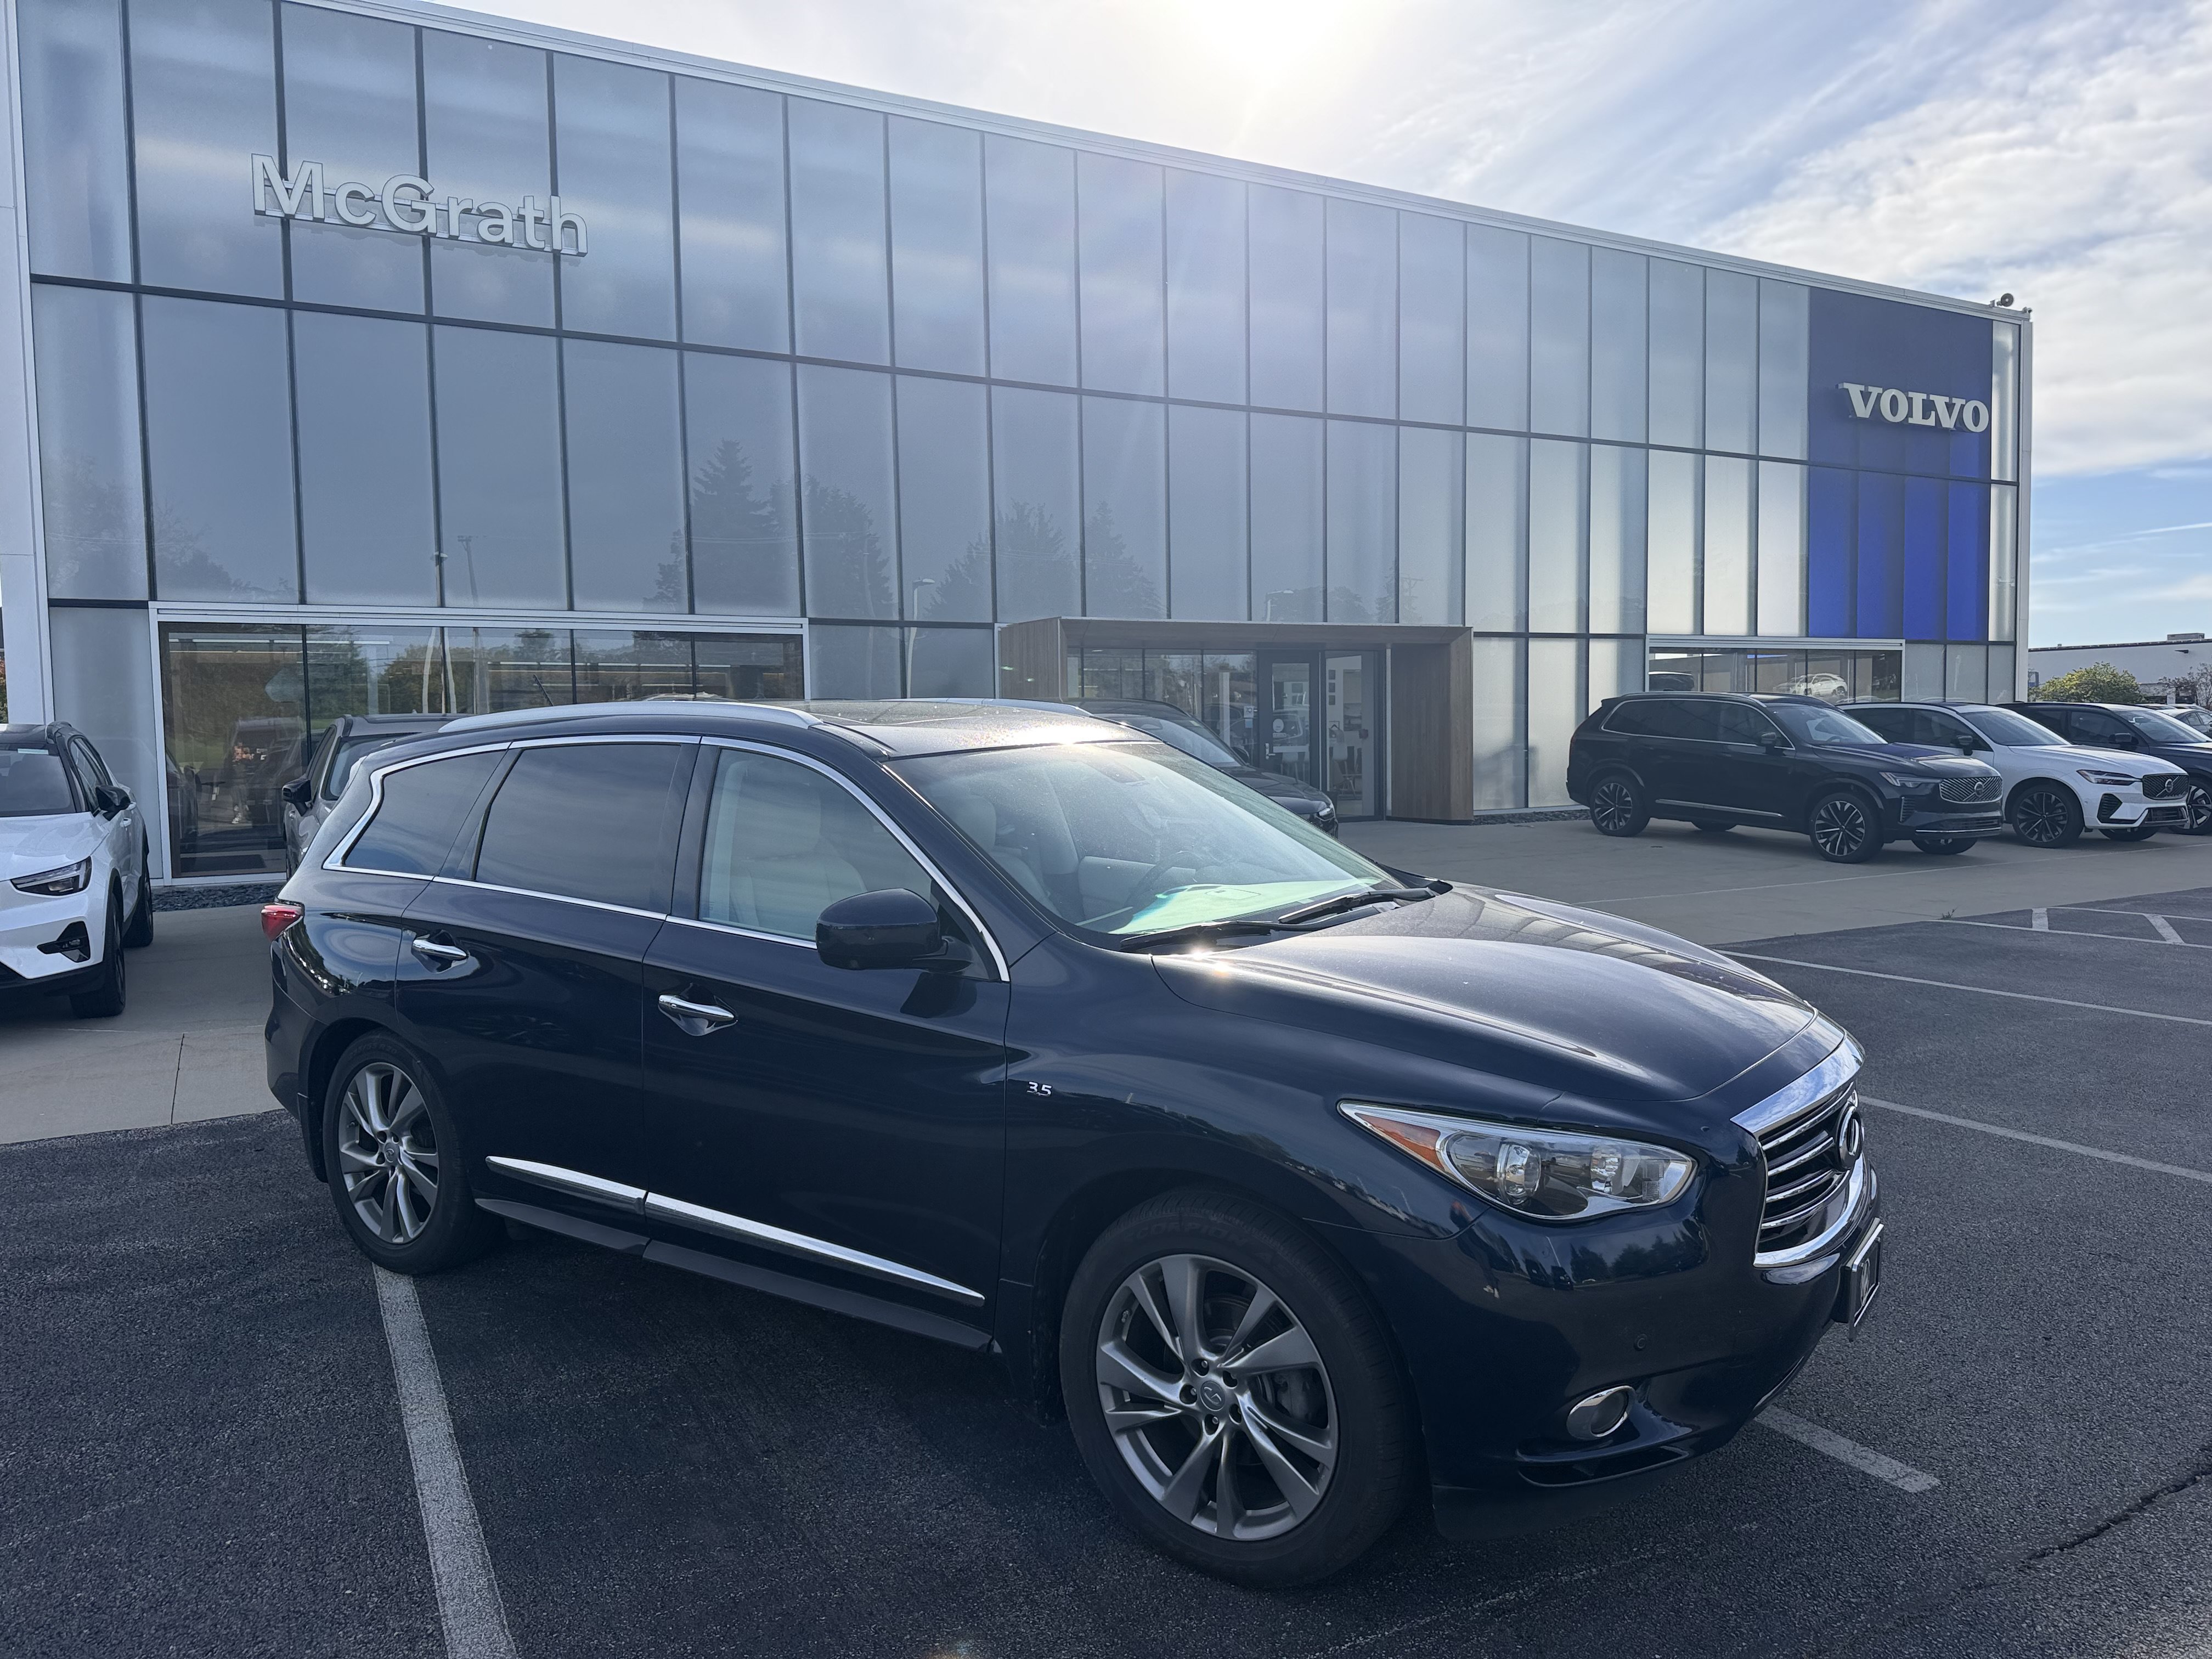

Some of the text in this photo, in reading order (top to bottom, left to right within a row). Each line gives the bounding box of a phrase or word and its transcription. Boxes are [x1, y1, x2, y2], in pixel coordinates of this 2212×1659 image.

[251, 153, 588, 257] McGrath
[1838, 382, 1989, 433] VOLVO
[1123, 1221, 1248, 1246] SCORPION
